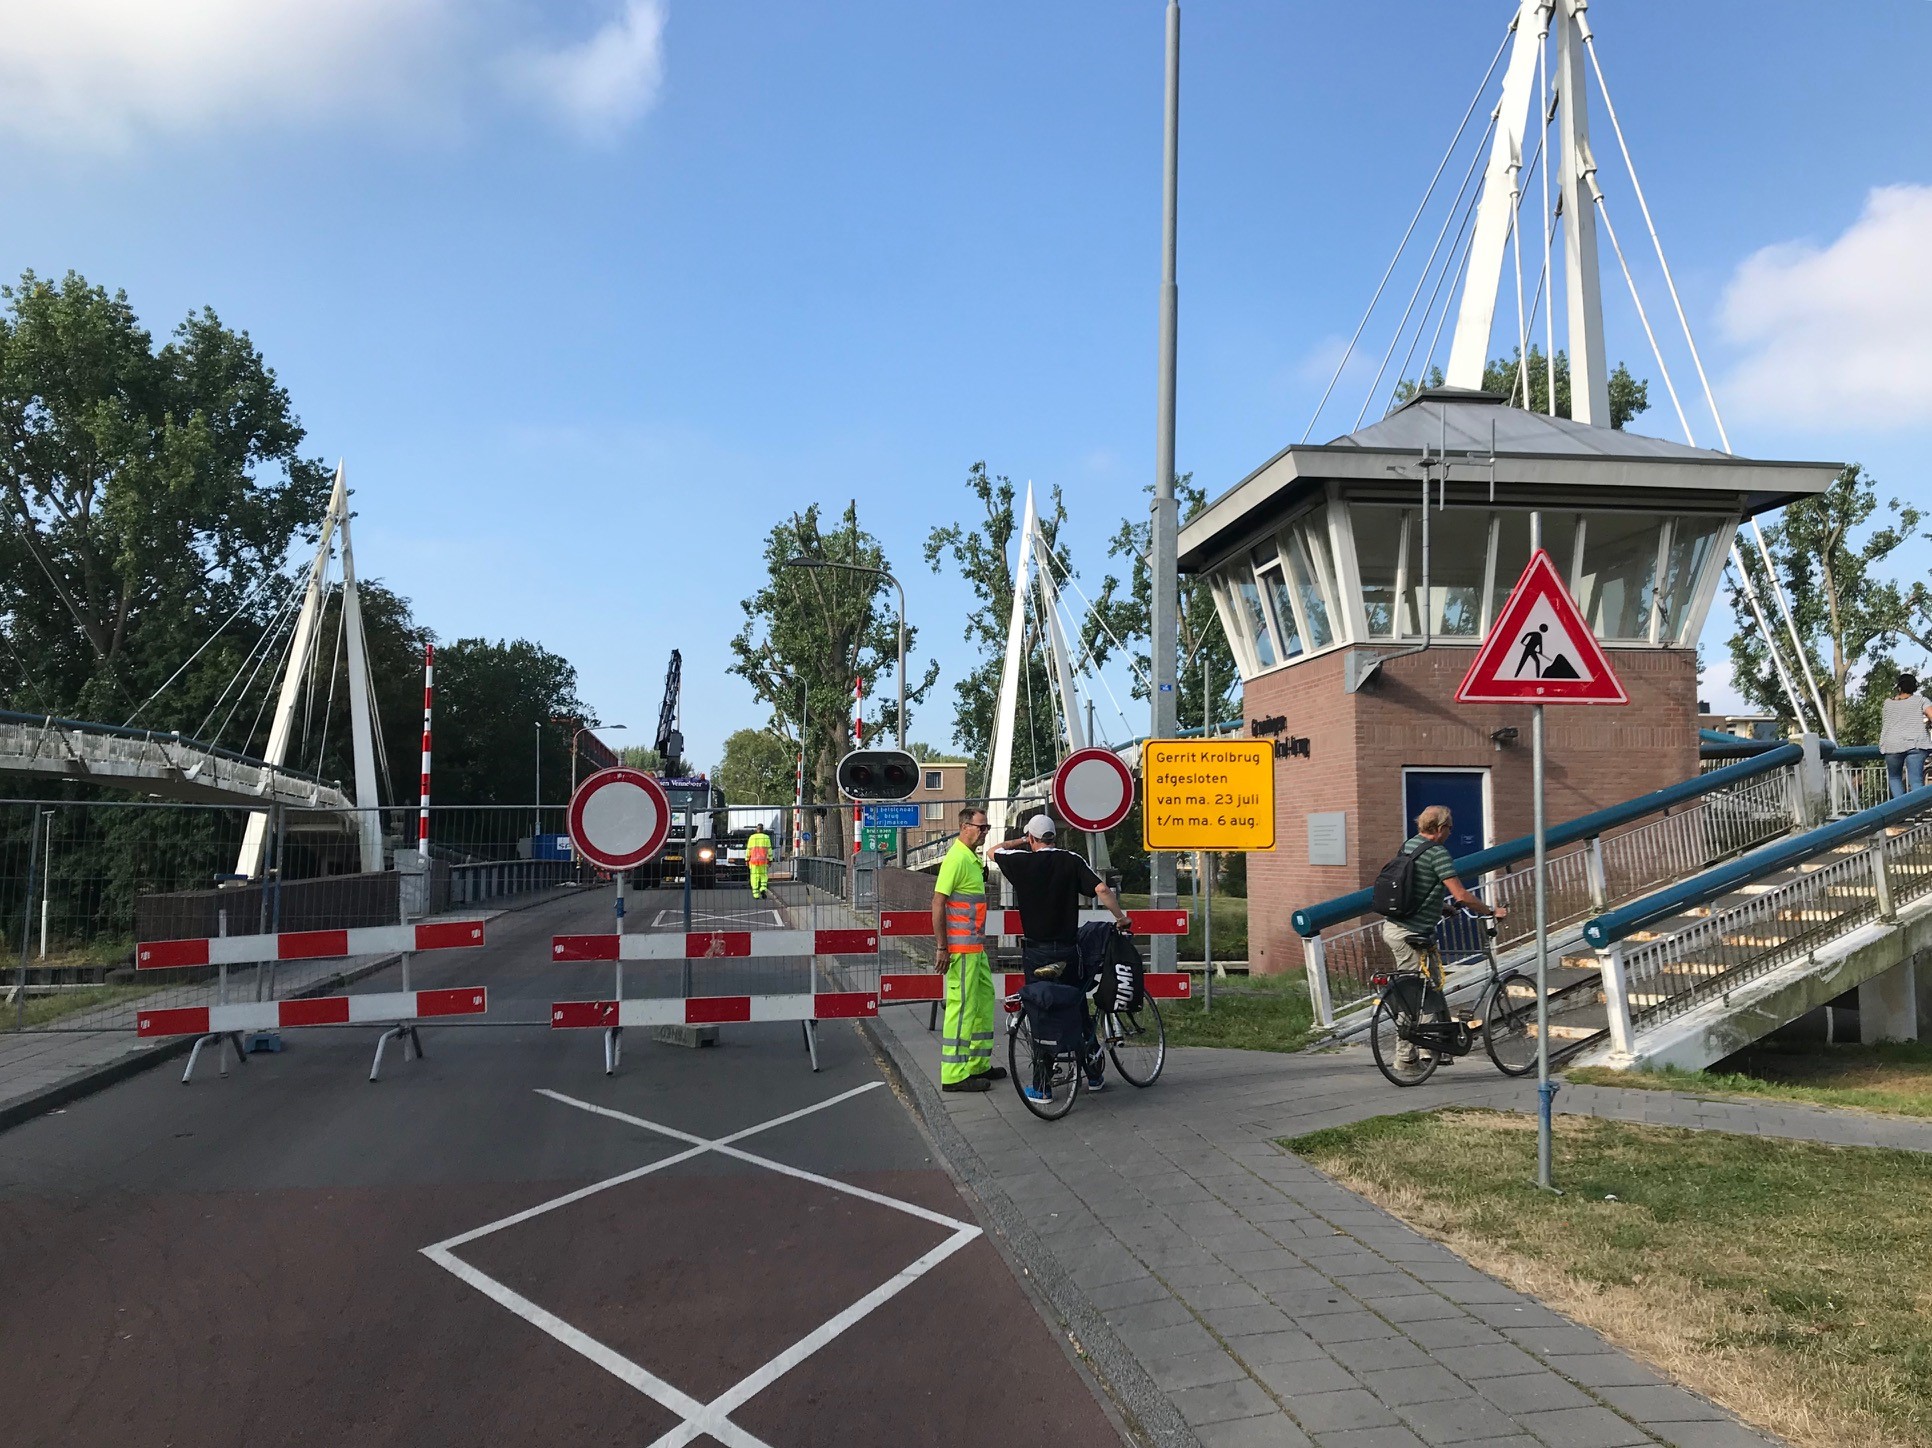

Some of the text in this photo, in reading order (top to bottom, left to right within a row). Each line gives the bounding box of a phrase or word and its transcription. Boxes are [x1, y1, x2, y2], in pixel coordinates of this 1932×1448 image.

[1156, 752, 1260, 765] Gerrit Krolbrug
[1156, 773, 1228, 787] afgesloten
[1157, 793, 1259, 808] van ma. 23 juli
[1156, 814, 1259, 829] t/m ma. 6 aug.
[1113, 964, 1134, 1011] PUMA
